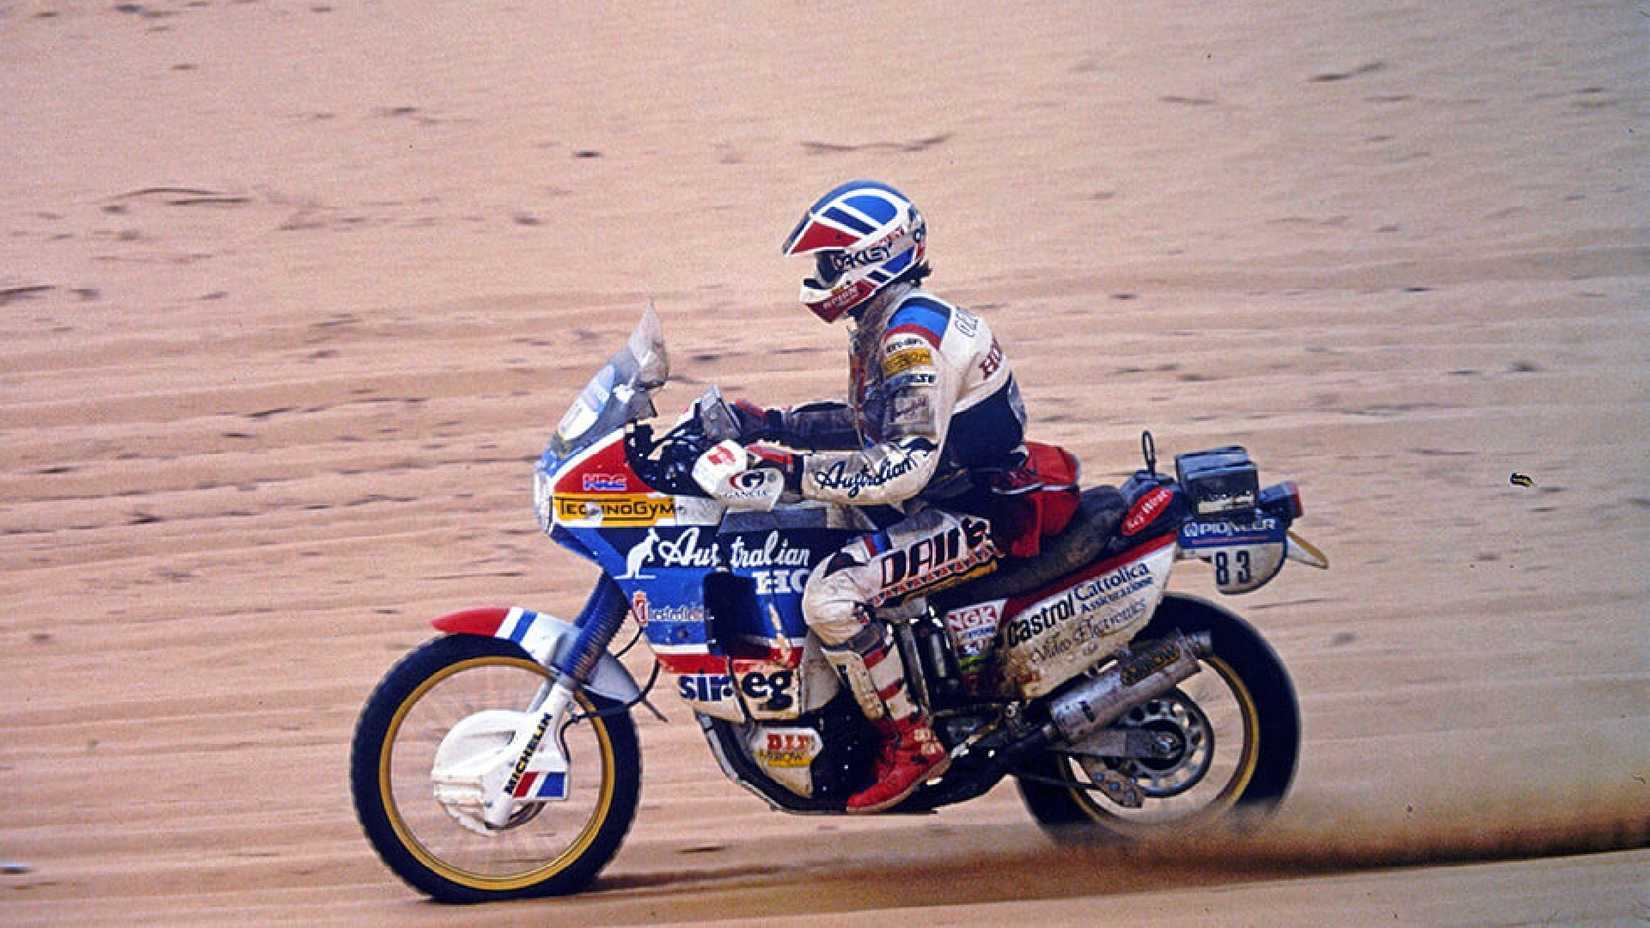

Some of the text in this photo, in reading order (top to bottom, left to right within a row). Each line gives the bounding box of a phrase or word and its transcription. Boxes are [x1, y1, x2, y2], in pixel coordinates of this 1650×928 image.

[658, 527, 810, 567] Australian
[1073, 562, 1149, 601] Cattolica
[1215, 550, 1250, 586] 83
[946, 606, 998, 633] NGK
[1007, 592, 1075, 648] Castrol
[504, 712, 552, 794] MICHELIN
